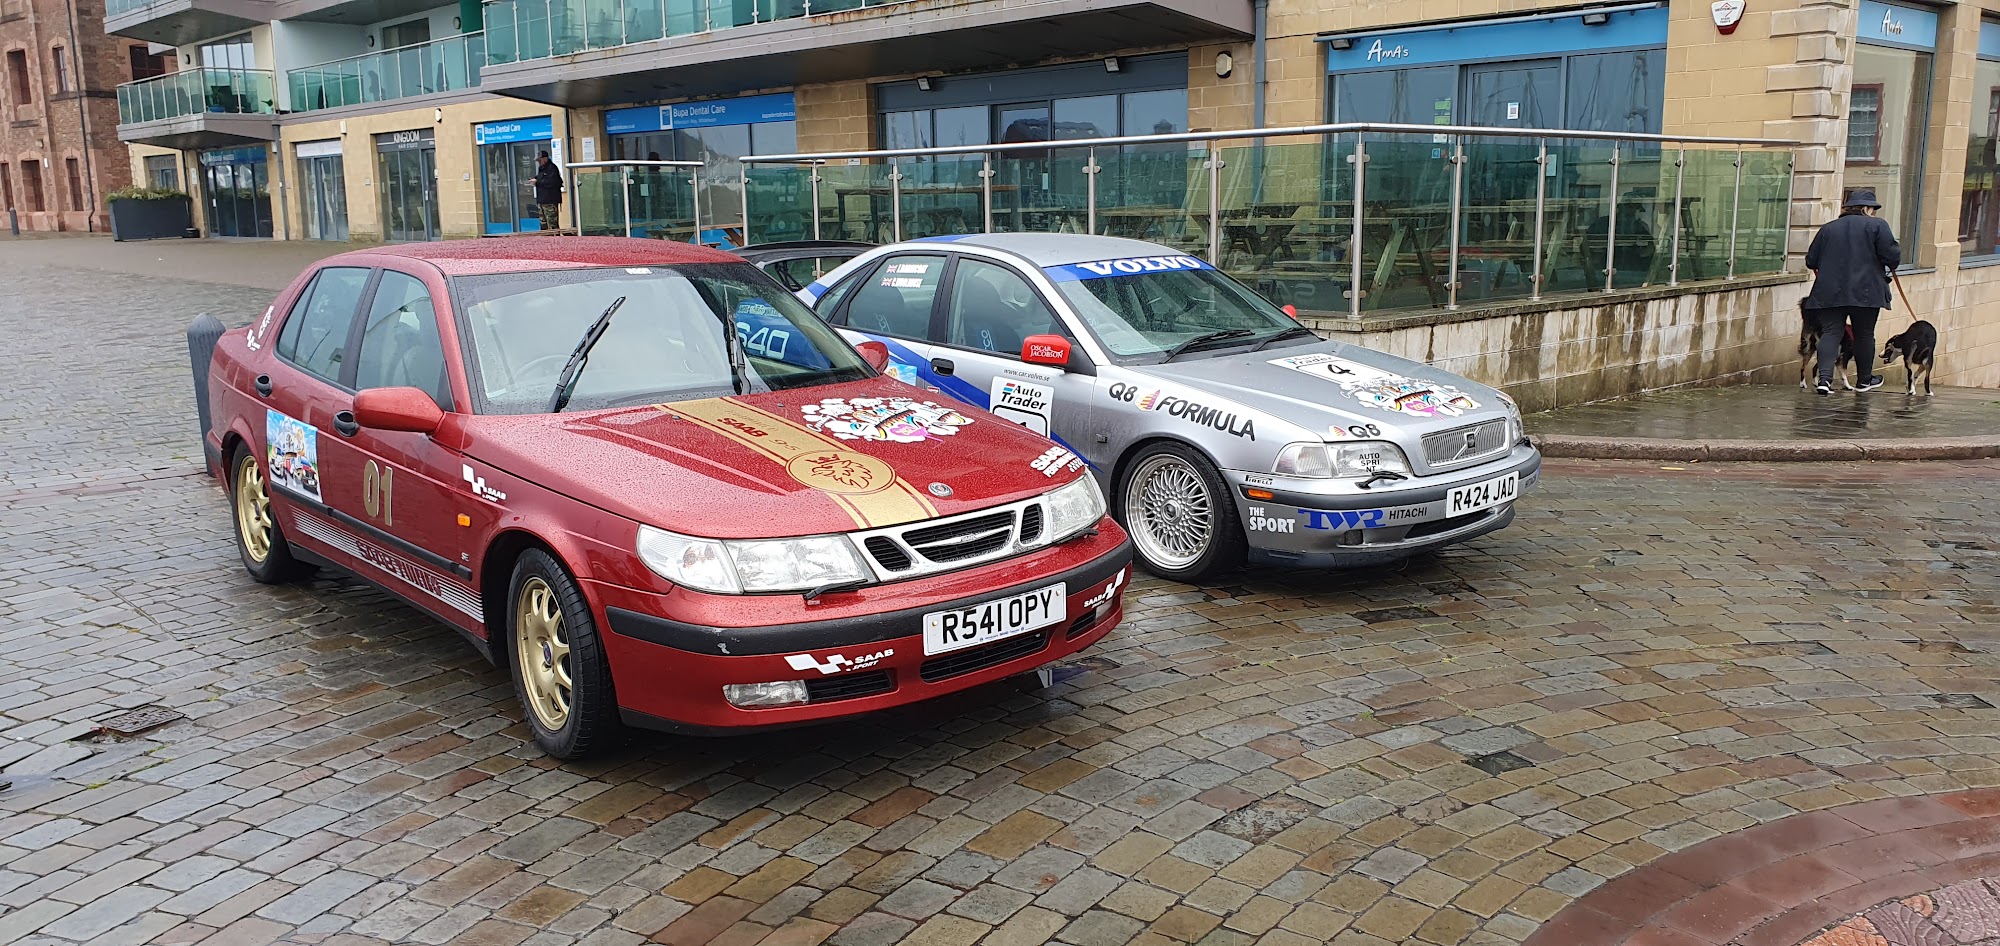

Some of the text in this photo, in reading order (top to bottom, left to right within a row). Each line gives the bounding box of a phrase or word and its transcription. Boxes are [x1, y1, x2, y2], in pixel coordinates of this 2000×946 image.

[673, 108, 689, 118] Bupa
[690, 106, 709, 115] Dental
[711, 105, 726, 114] Care
[393, 130, 420, 144] KINGDOM
[1076, 256, 1201, 275] VOLVO
[1030, 344, 1052, 352] OSCAR
[1030, 350, 1064, 358] JACOBSON
[1292, 357, 1332, 365] Trader
[1003, 369, 1050, 382] www.car.volvo.se
[1327, 364, 1356, 376] 4
[1013, 385, 1042, 398] Auto
[1001, 391, 1047, 410] Trader
[1109, 382, 1256, 441] Q8 FORMULA
[717, 417, 768, 438] SAAB
[1348, 423, 1381, 438] Q8
[1030, 446, 1068, 471] SAAB
[1359, 452, 1380, 460] AUTO
[1245, 474, 1274, 486] PIRELLI
[363, 459, 393, 527] 01
[487, 487, 507, 500] SAAB
[1453, 483, 1490, 512] R424
[1493, 476, 1515, 501] JAD
[1248, 507, 1265, 517] THE
[1297, 507, 1428, 530] TWR HITACHI
[1249, 517, 1296, 534] SPORT
[1083, 594, 1103, 608] SAAB
[942, 590, 1053, 644] R541 OPY
[854, 648, 894, 663] SAAB
[852, 659, 879, 671] SPORT
